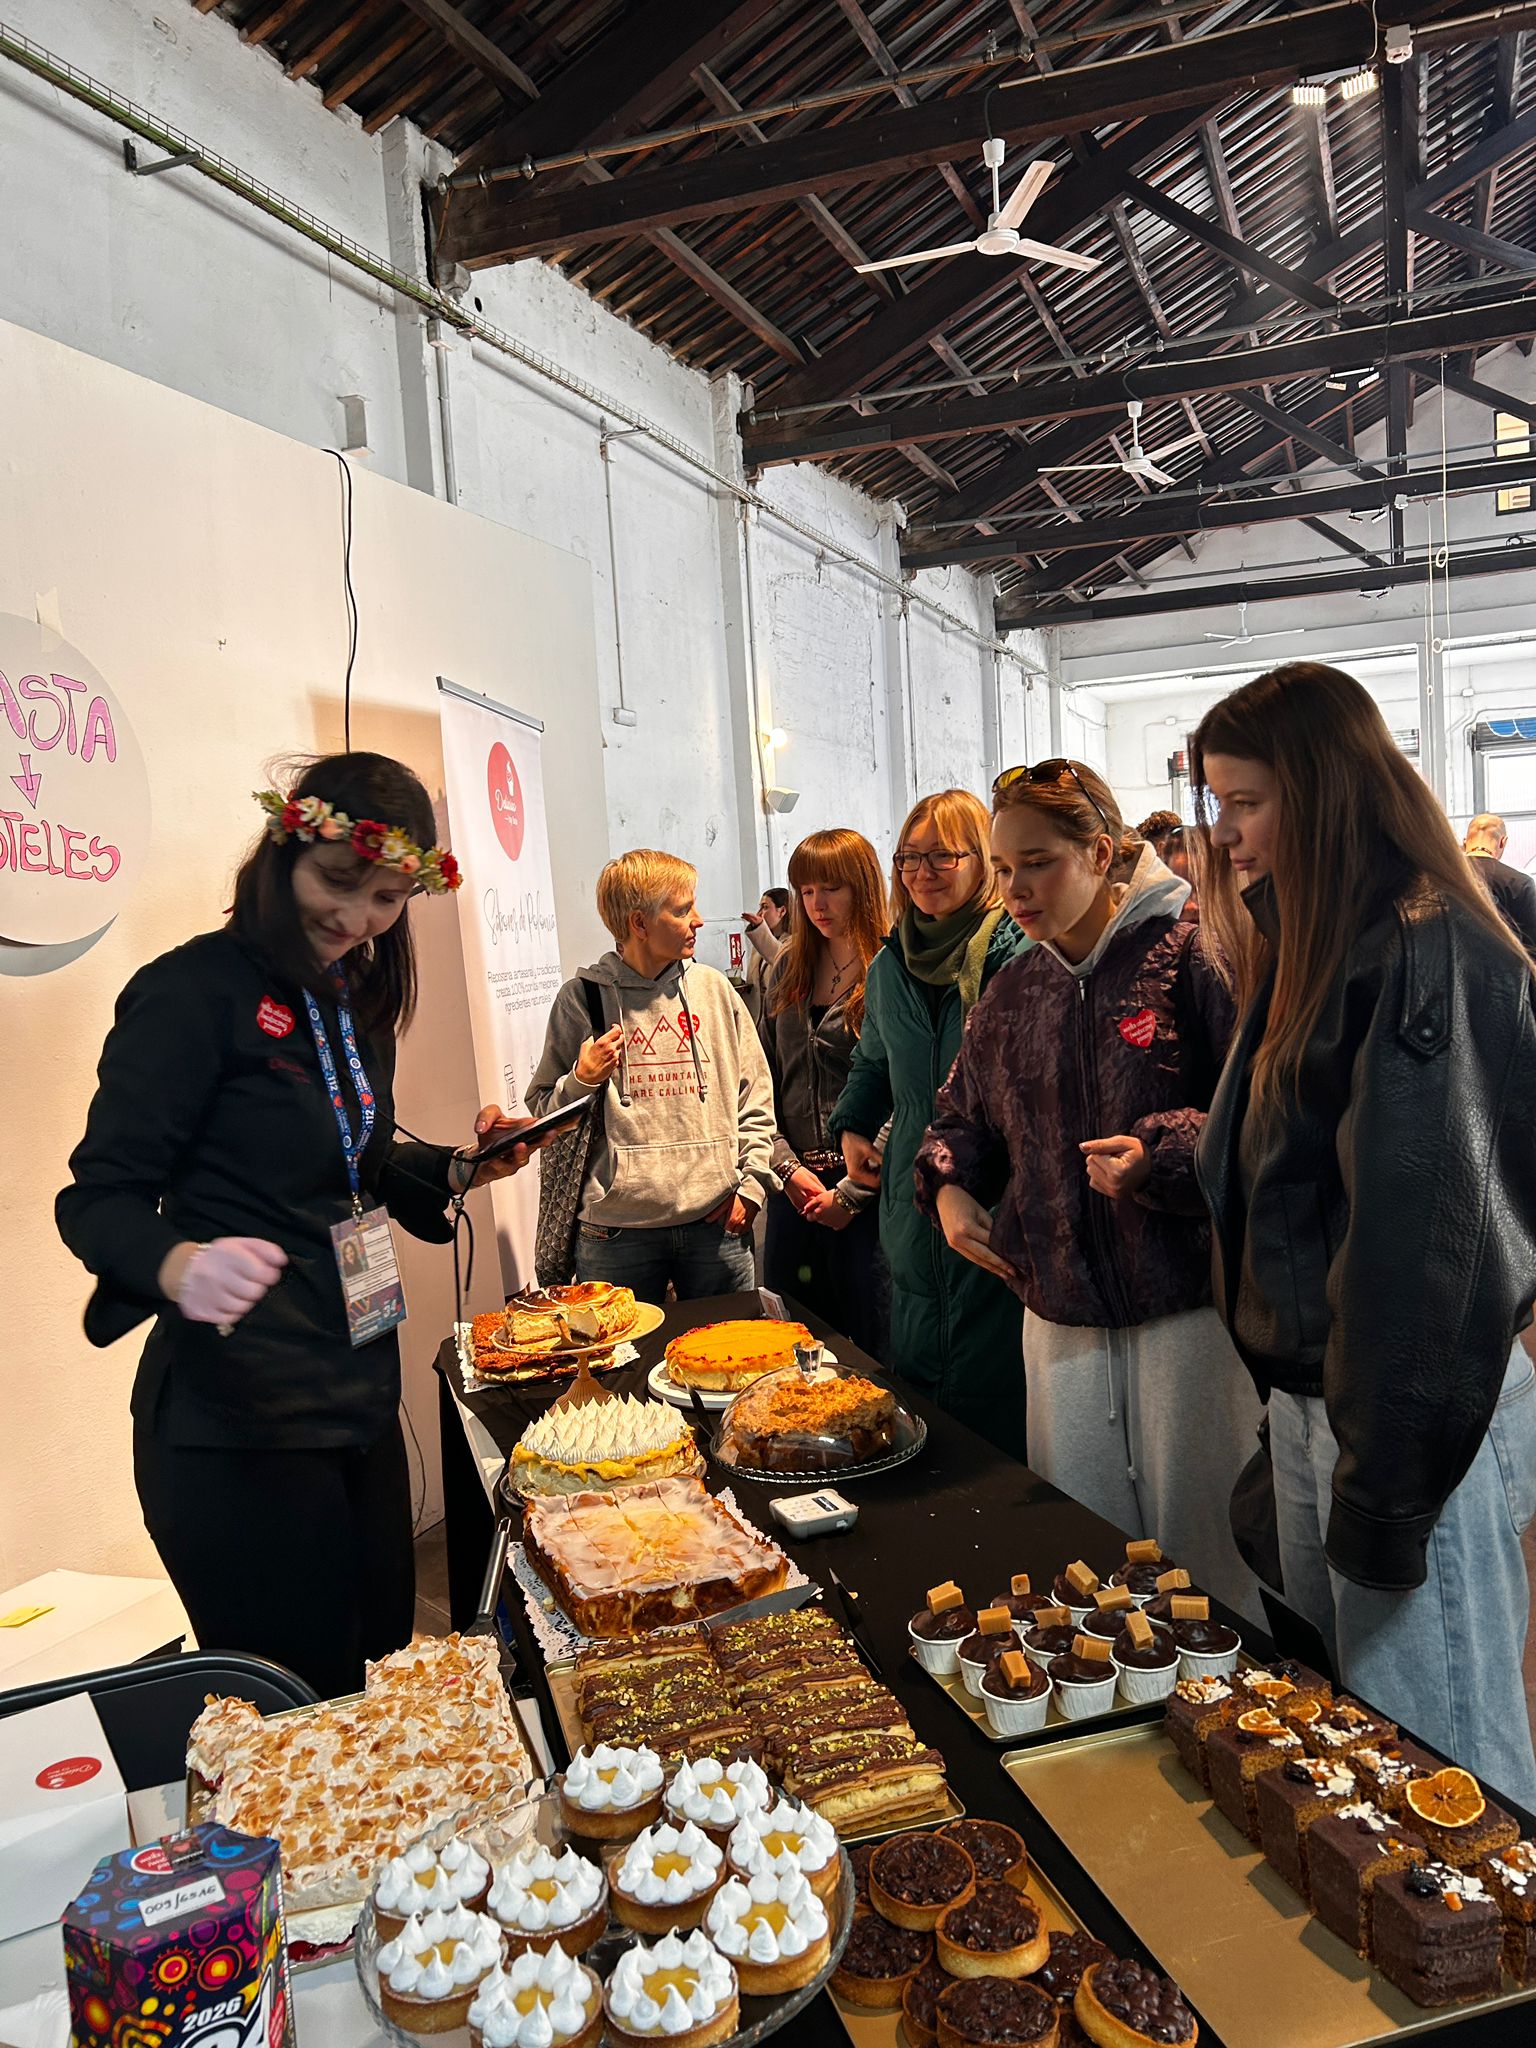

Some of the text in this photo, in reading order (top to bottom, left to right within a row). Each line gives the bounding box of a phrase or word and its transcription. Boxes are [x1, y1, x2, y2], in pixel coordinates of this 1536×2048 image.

[327, 1075, 338, 1092] 112
[629, 1074, 642, 1084] HE
[633, 1088, 653, 1099] ARE
[365, 1109, 375, 1126] 112
[181, 1995, 243, 2034] 2026
